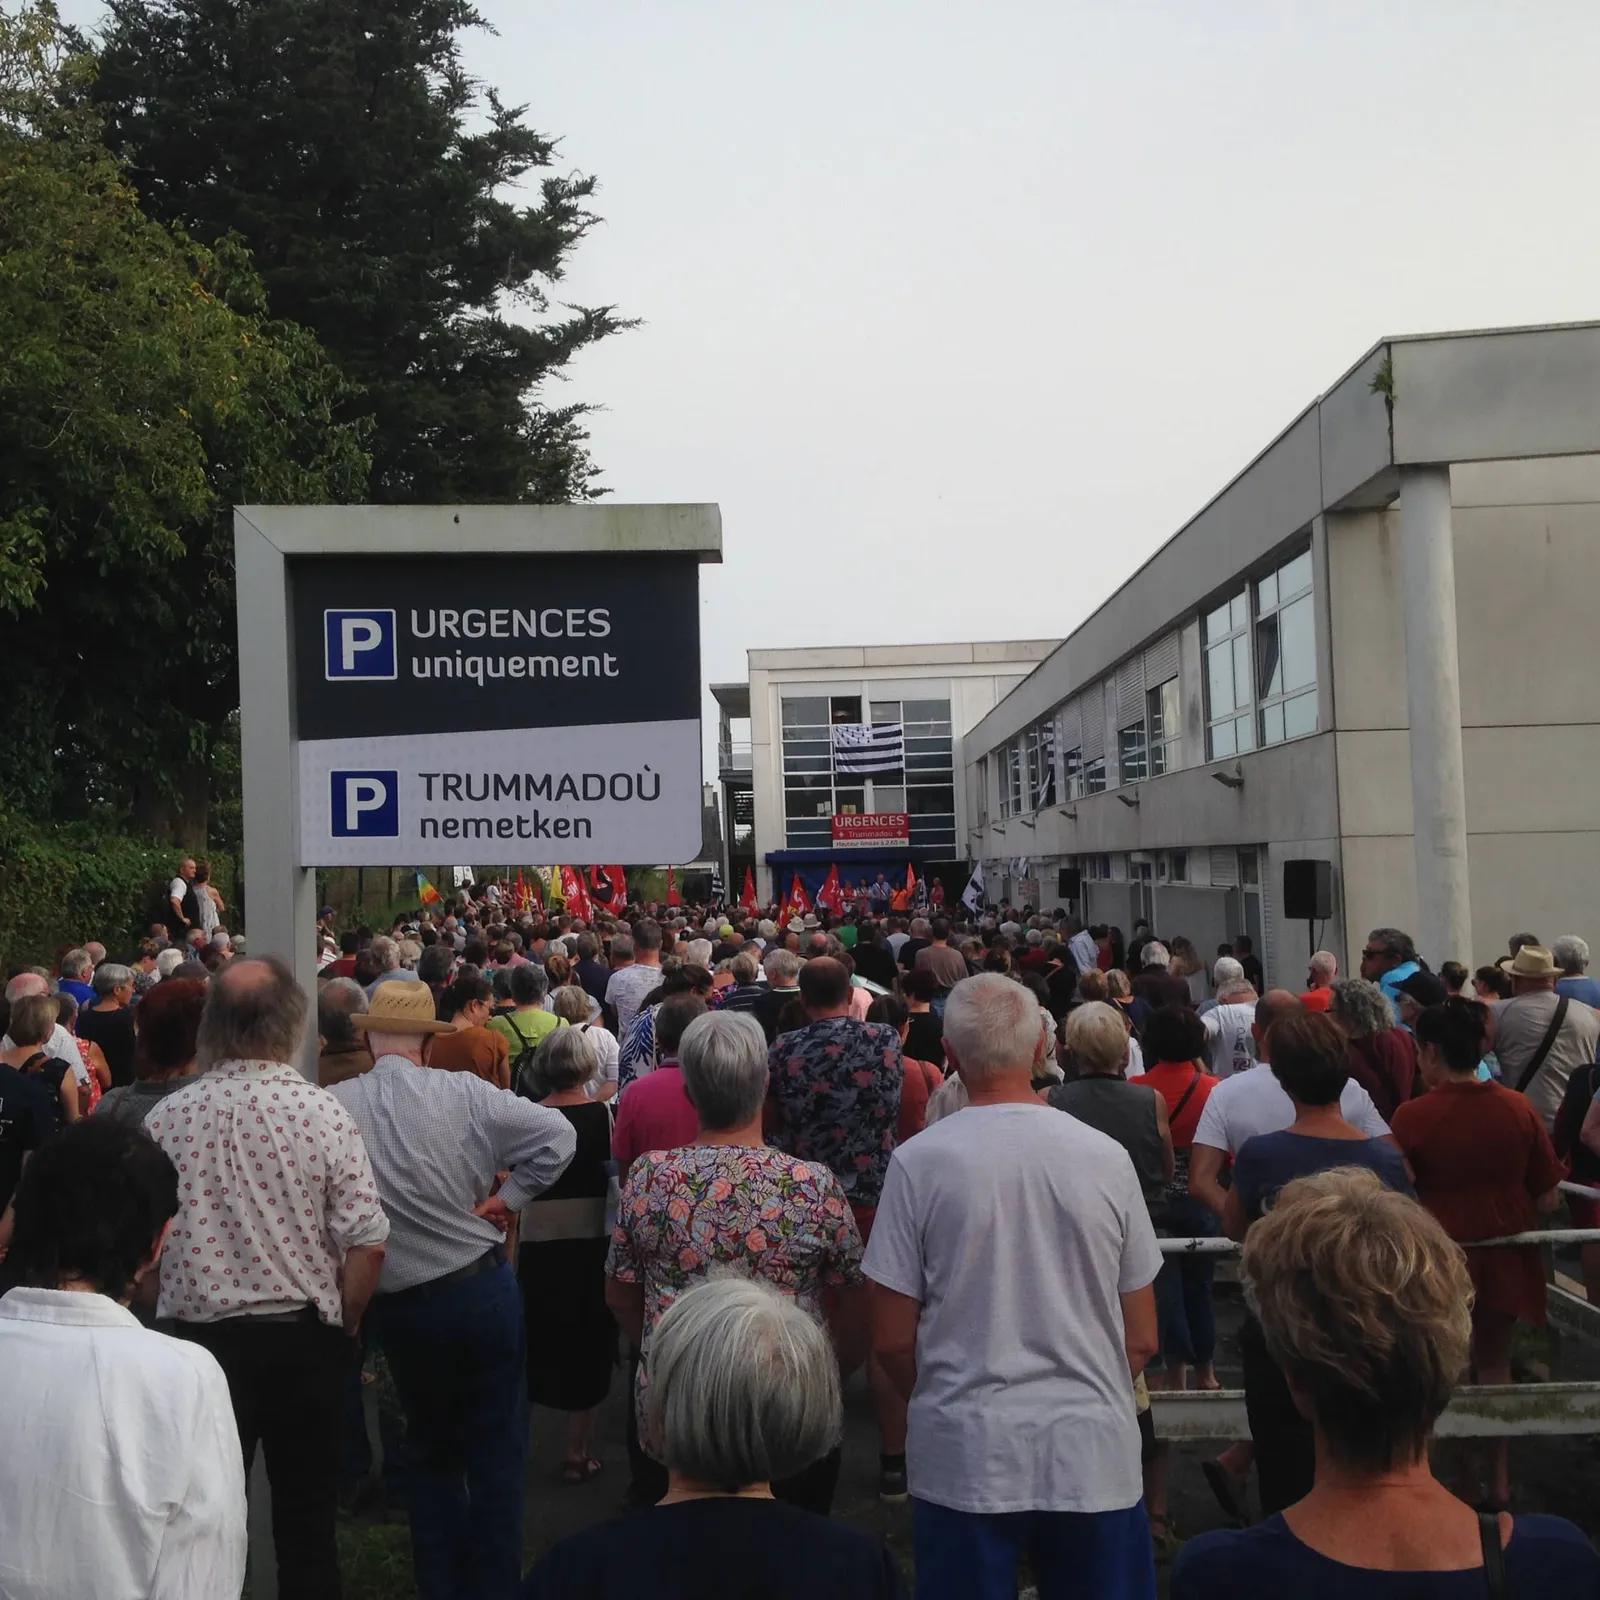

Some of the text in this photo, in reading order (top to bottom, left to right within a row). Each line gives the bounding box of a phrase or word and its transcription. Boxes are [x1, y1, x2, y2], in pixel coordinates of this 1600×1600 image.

[411, 608, 611, 638] URGENCES
[341, 618, 382, 669] P
[412, 650, 620, 686] uniquement
[418, 764, 661, 801] TRUMMADOÙ
[345, 777, 387, 830] P
[835, 815, 905, 828] URGENCES
[420, 809, 592, 839] nemetken
